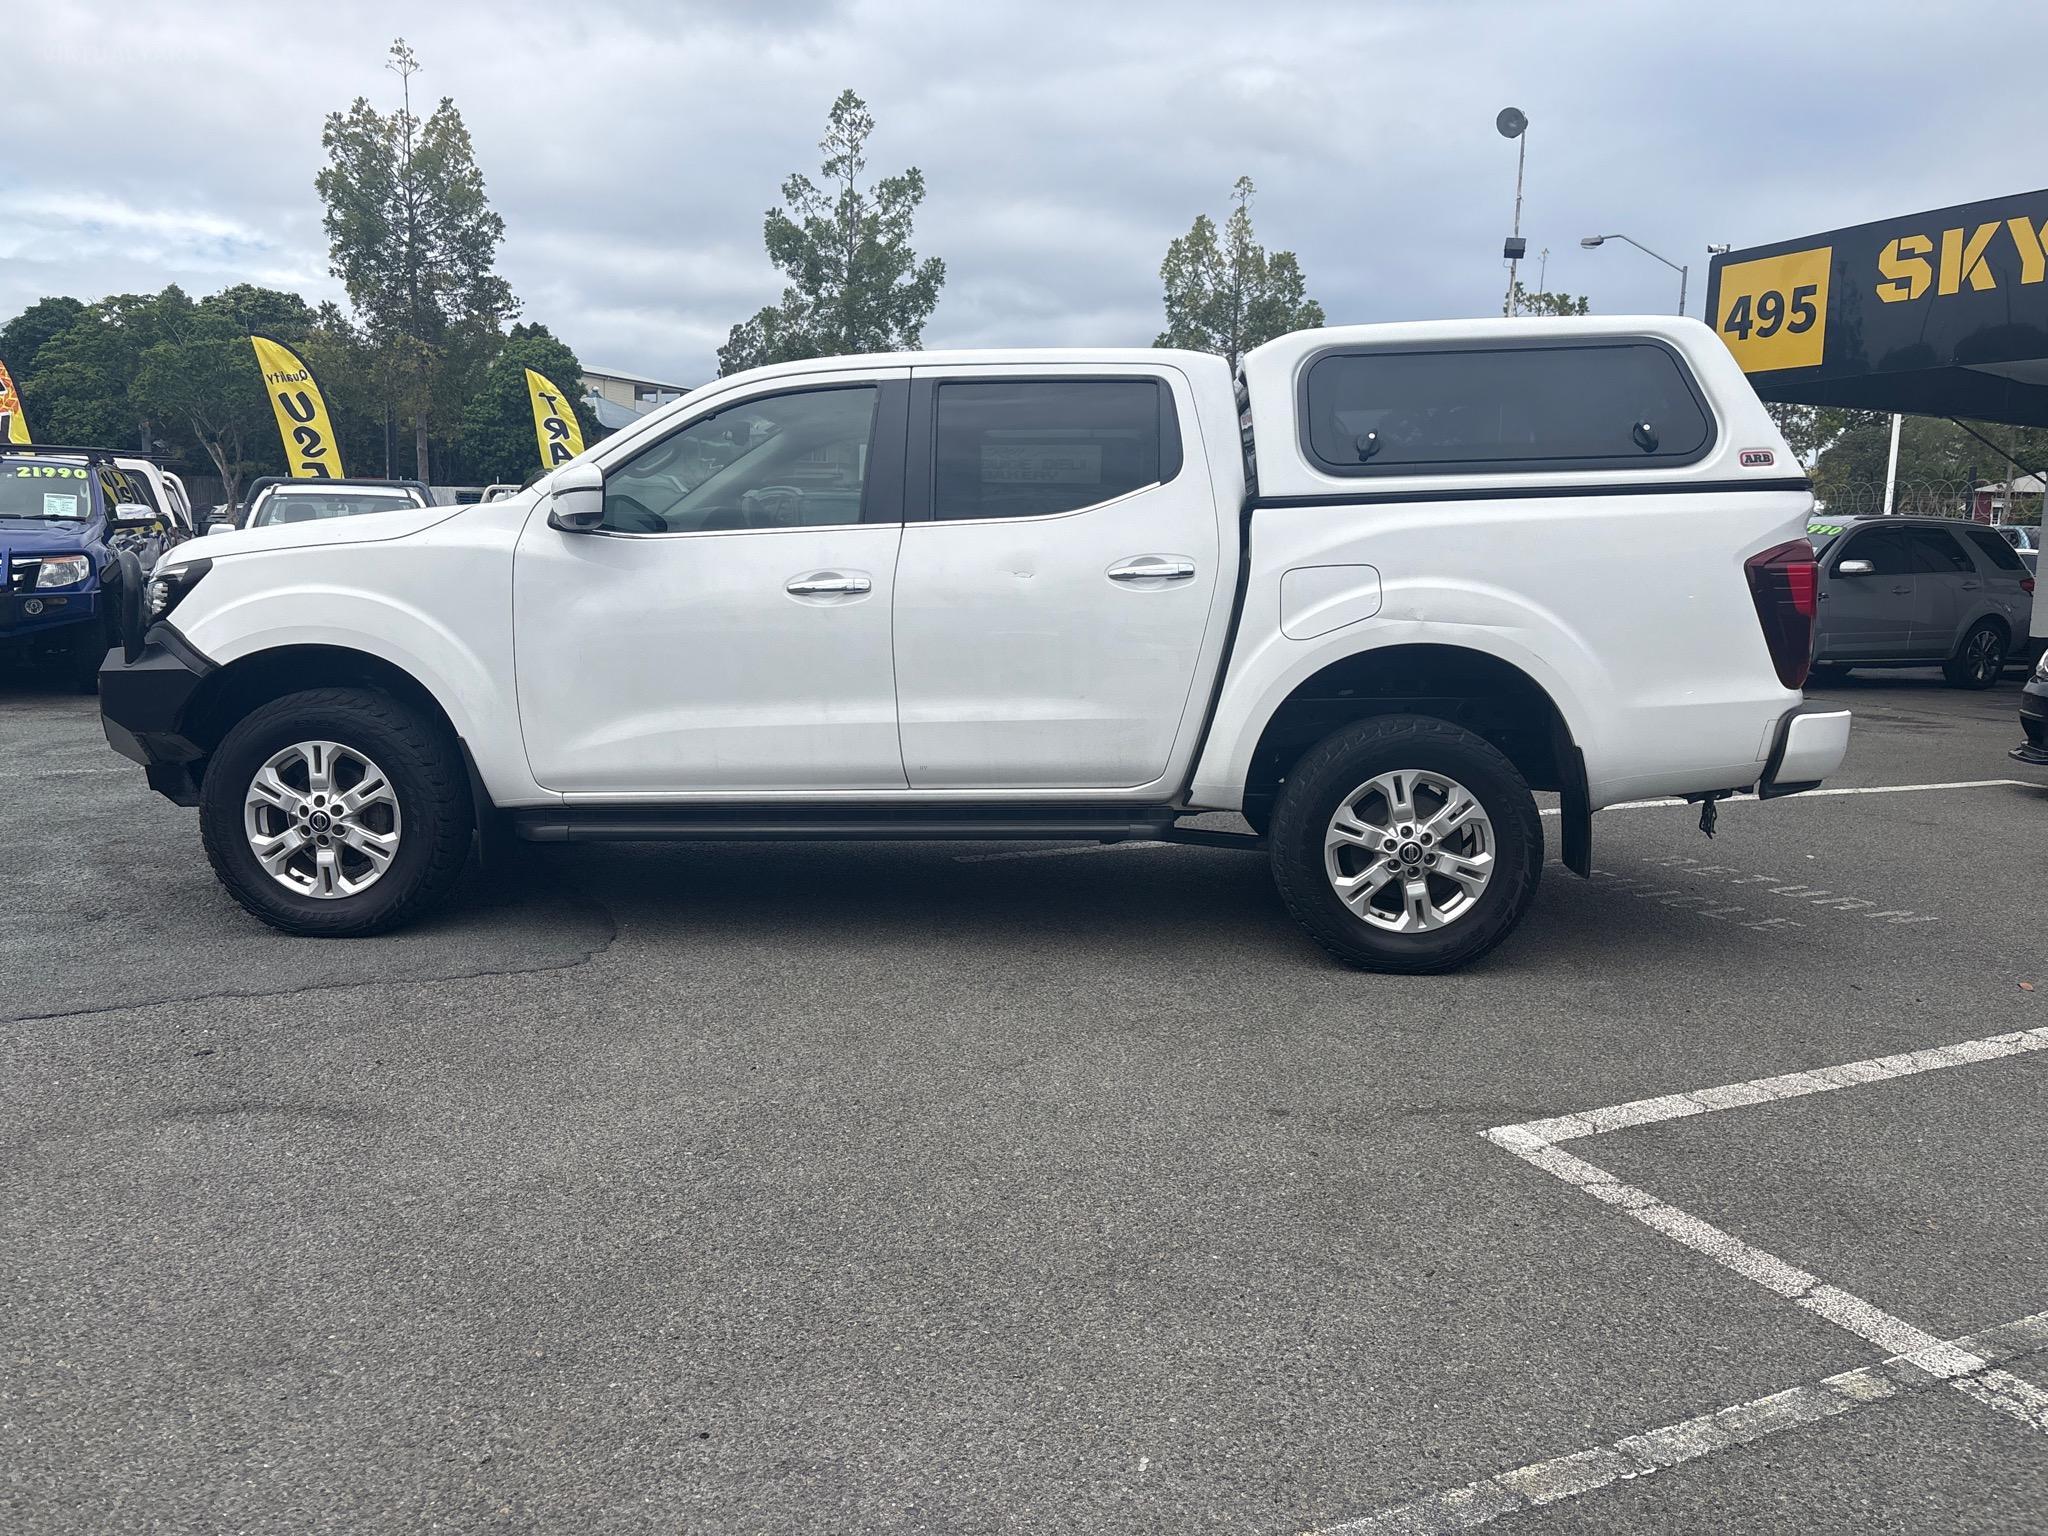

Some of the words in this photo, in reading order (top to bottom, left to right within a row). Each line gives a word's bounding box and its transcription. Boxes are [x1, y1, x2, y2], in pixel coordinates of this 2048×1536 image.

[1876, 216, 2048, 303] SKY
[1724, 284, 1817, 340] 495
[1744, 453, 1772, 464] ARB
[16, 466, 89, 480] 21990
[1807, 523, 1844, 535] 990
